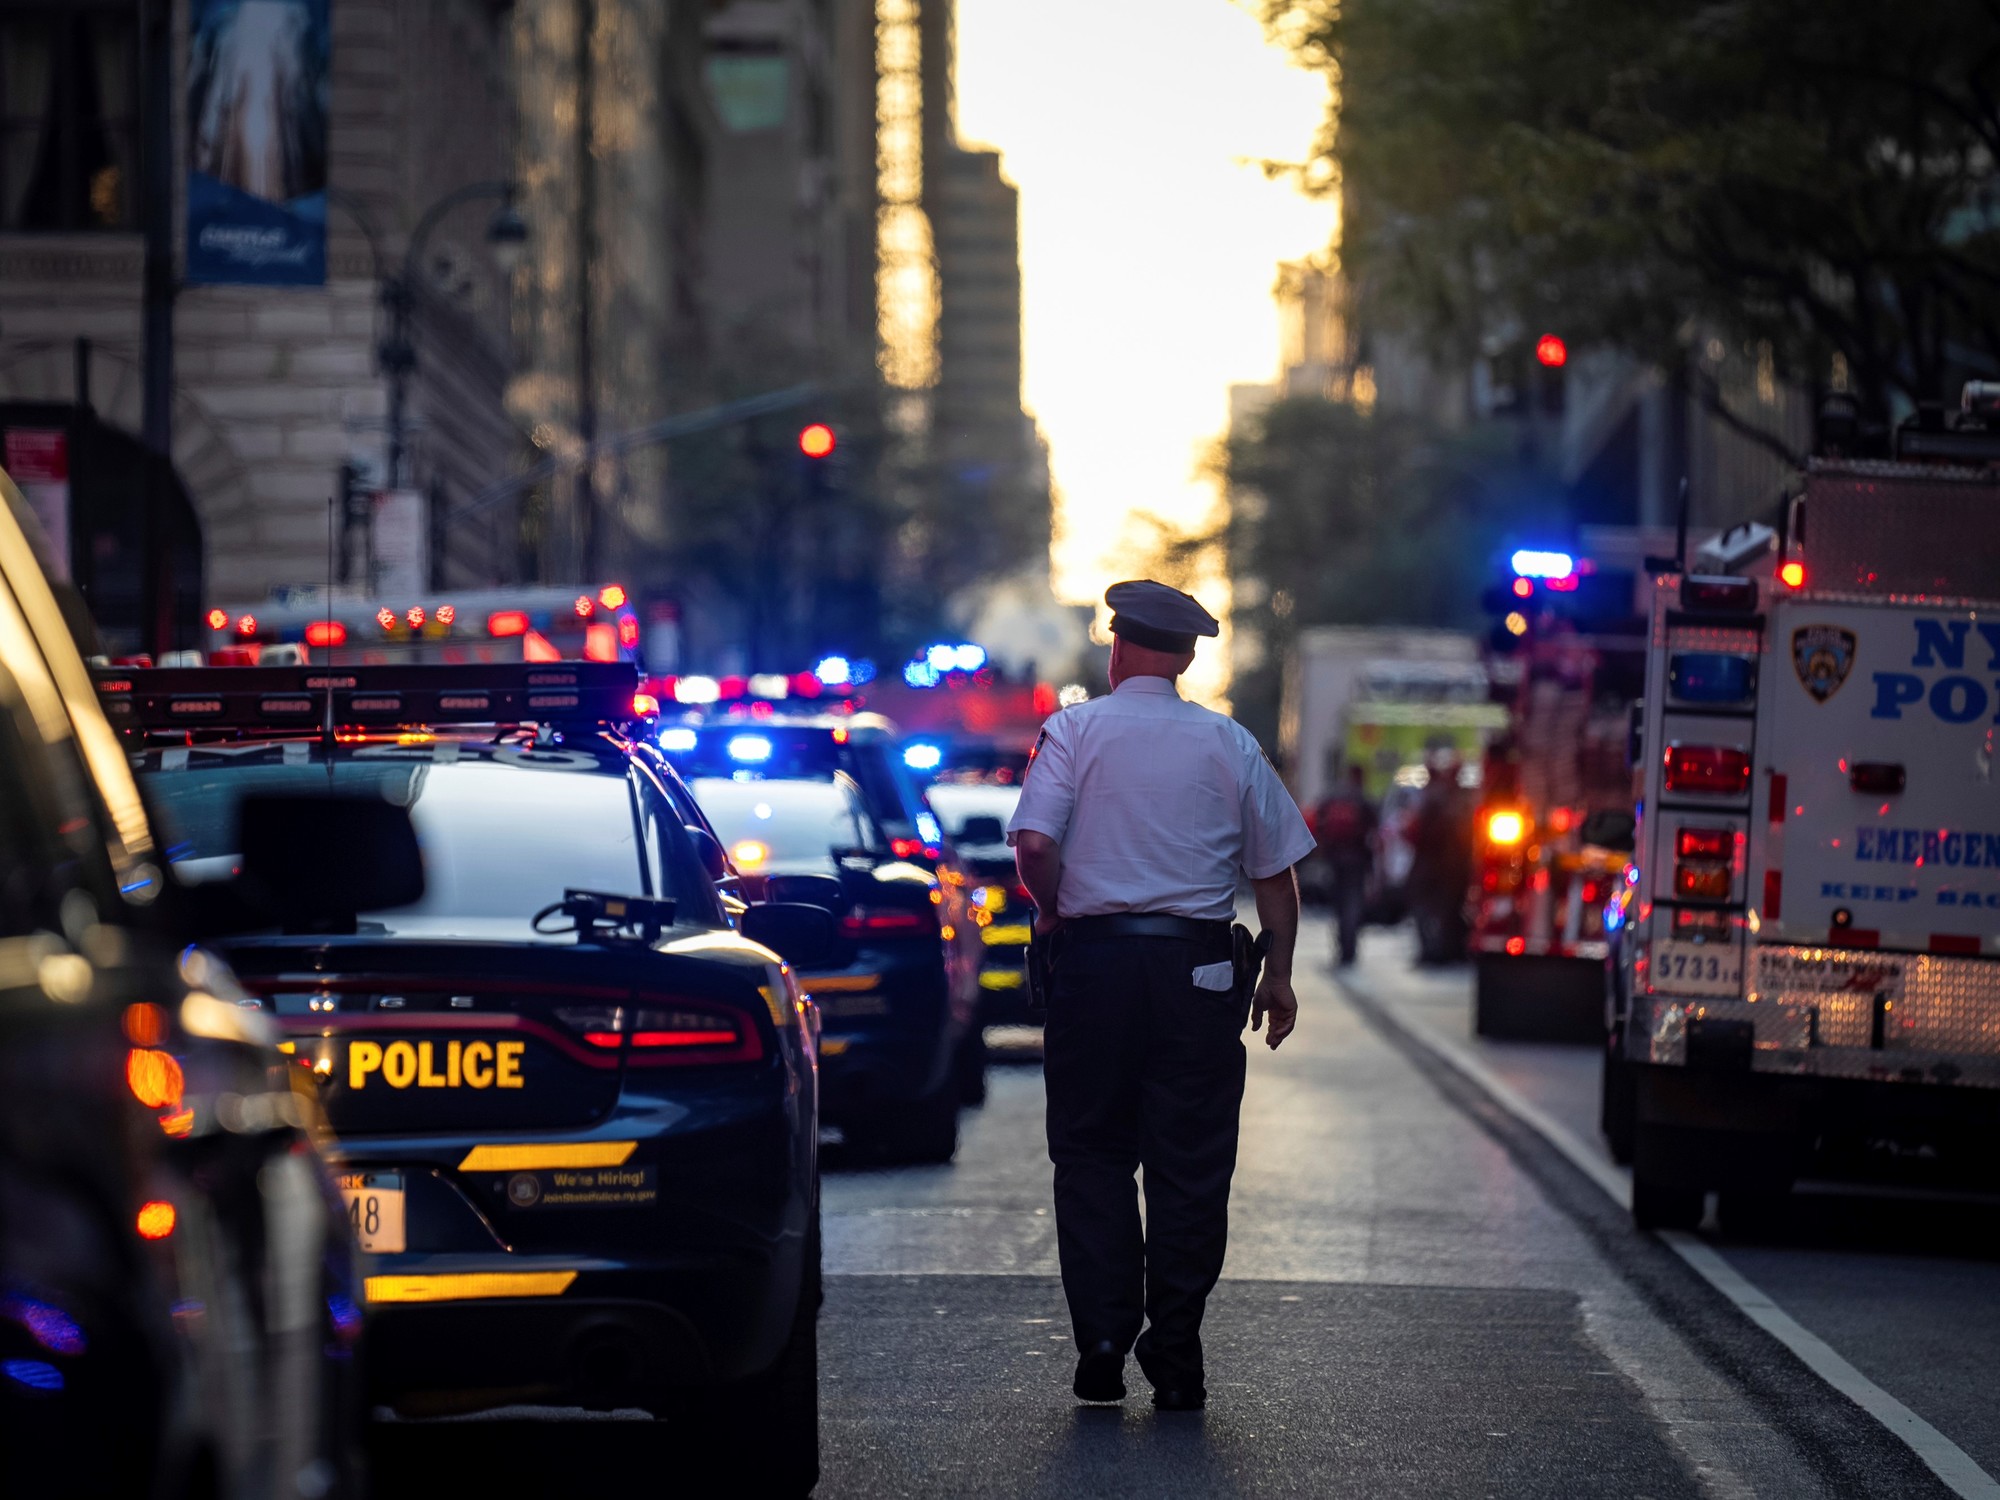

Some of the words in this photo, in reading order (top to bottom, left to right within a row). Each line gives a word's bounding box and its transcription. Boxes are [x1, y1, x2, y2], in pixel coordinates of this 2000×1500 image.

[1870, 671, 2000, 725] PO
[1821, 882, 1918, 902] KEEP
[1658, 953, 1719, 981] 5733
[349, 1040, 524, 1089] POLICE
[336, 1173, 366, 1190] RK
[553, 1172, 593, 1187] We're
[598, 1170, 645, 1188] Hiring!
